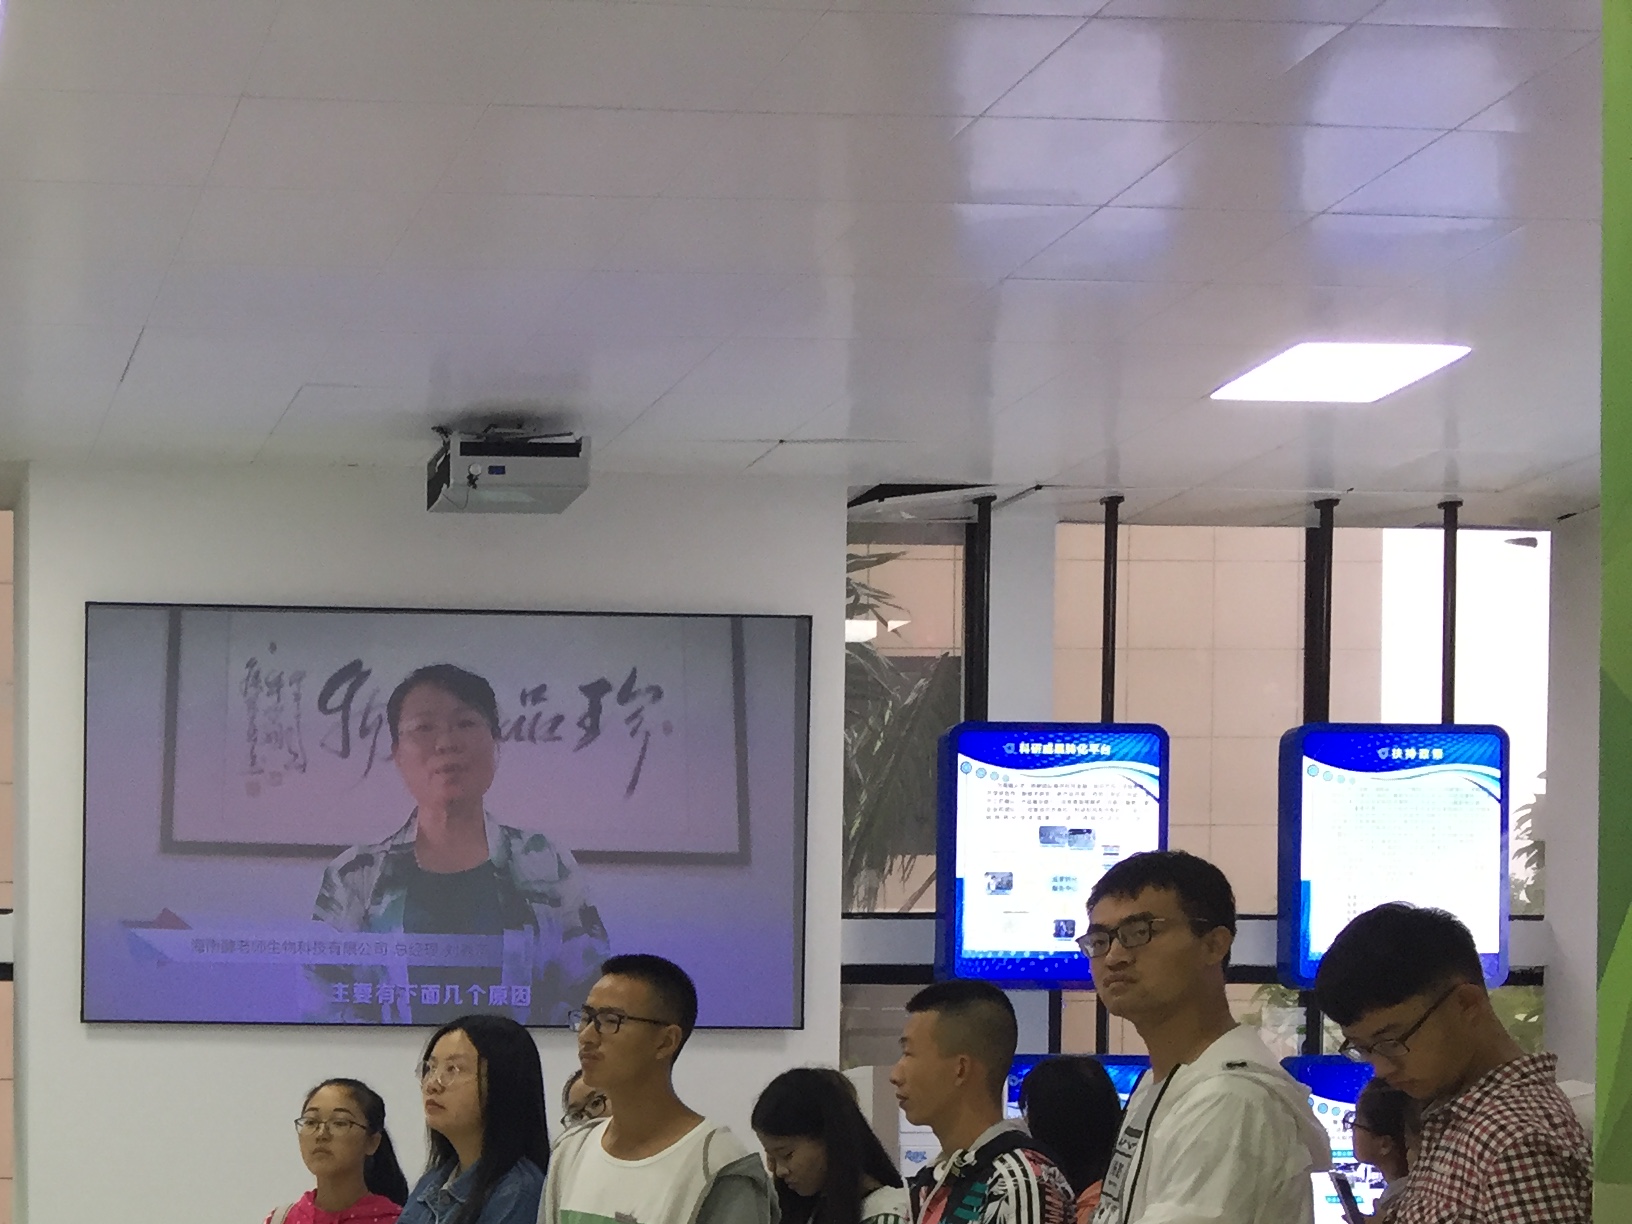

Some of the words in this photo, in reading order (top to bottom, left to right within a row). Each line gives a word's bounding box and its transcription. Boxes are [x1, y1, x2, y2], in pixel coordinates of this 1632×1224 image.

[1019, 741, 1111, 755] 科研成果转化平台
[331, 982, 532, 1008] 主要有下面几个原因
